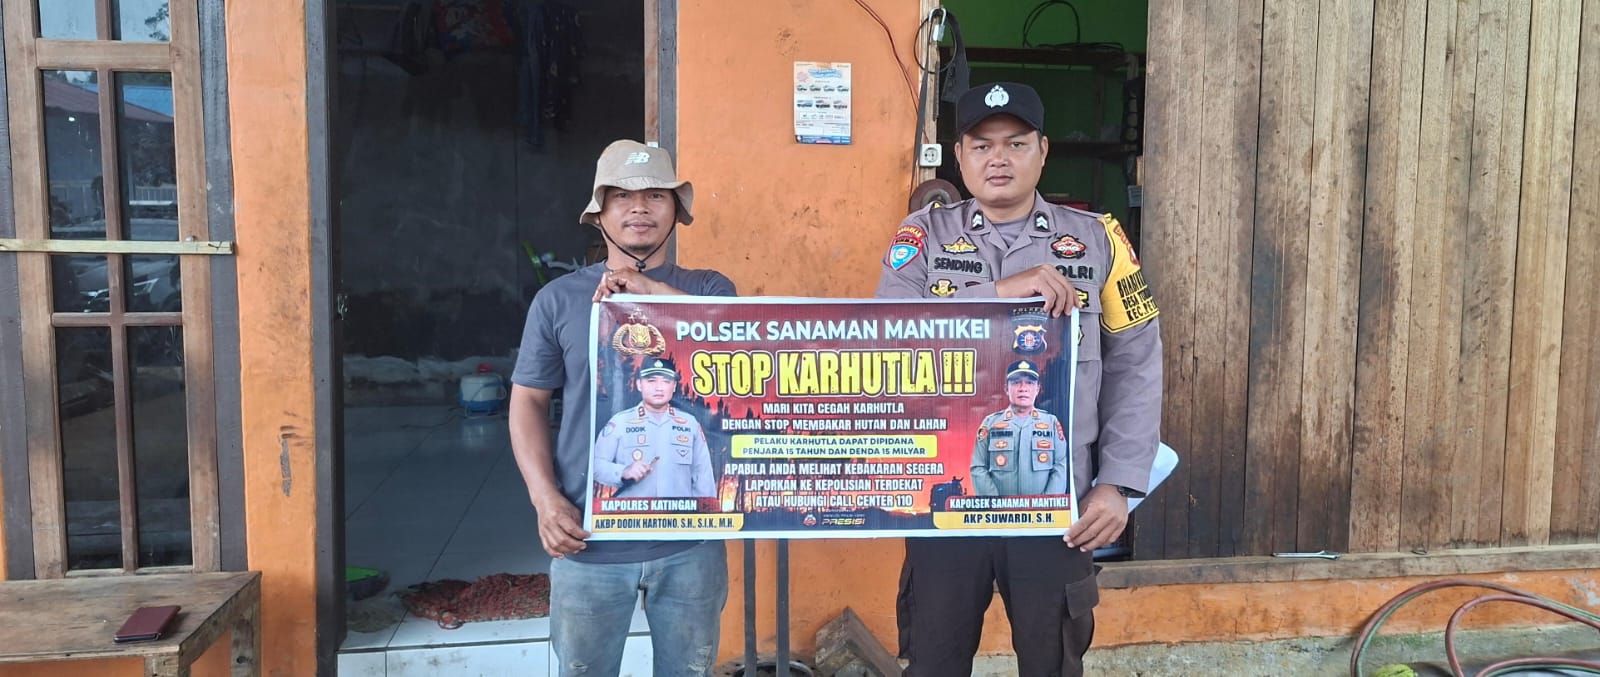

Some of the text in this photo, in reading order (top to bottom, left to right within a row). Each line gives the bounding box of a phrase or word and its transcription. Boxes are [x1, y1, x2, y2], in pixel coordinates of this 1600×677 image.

[934, 256, 983, 274] SENDING
[1054, 264, 1094, 280] OLRI
[676, 319, 990, 342] POLSEK SANAMAN MANTIKEI
[692, 349, 976, 396] STOP KARHUTLA !!!
[763, 402, 905, 414] MARI KITA CEGAH KARHUTLA
[722, 419, 947, 430] DENGAN STOP MEMBAKAR HUTAN DAN LAHAN
[725, 463, 944, 475] APABILA ANDA MELIHAT KEBAKARAN SEGERA
[745, 479, 923, 491] LAPORKAN KE KEPOLISIAN TERDEKAT
[601, 499, 697, 511] KAPOLRES KATINGAN
[756, 495, 913, 507] ATAU HUBUNGI CALL CENTER 110
[950, 497, 1068, 509] KAPOLSEK SANAMAN MANTIKEI
[595, 518, 616, 529] AKBP
[617, 518, 641, 529] DODIK
[718, 517, 734, 528] M.H.
[963, 513, 983, 524] AKP
[1036, 513, 1054, 523] S.H.
